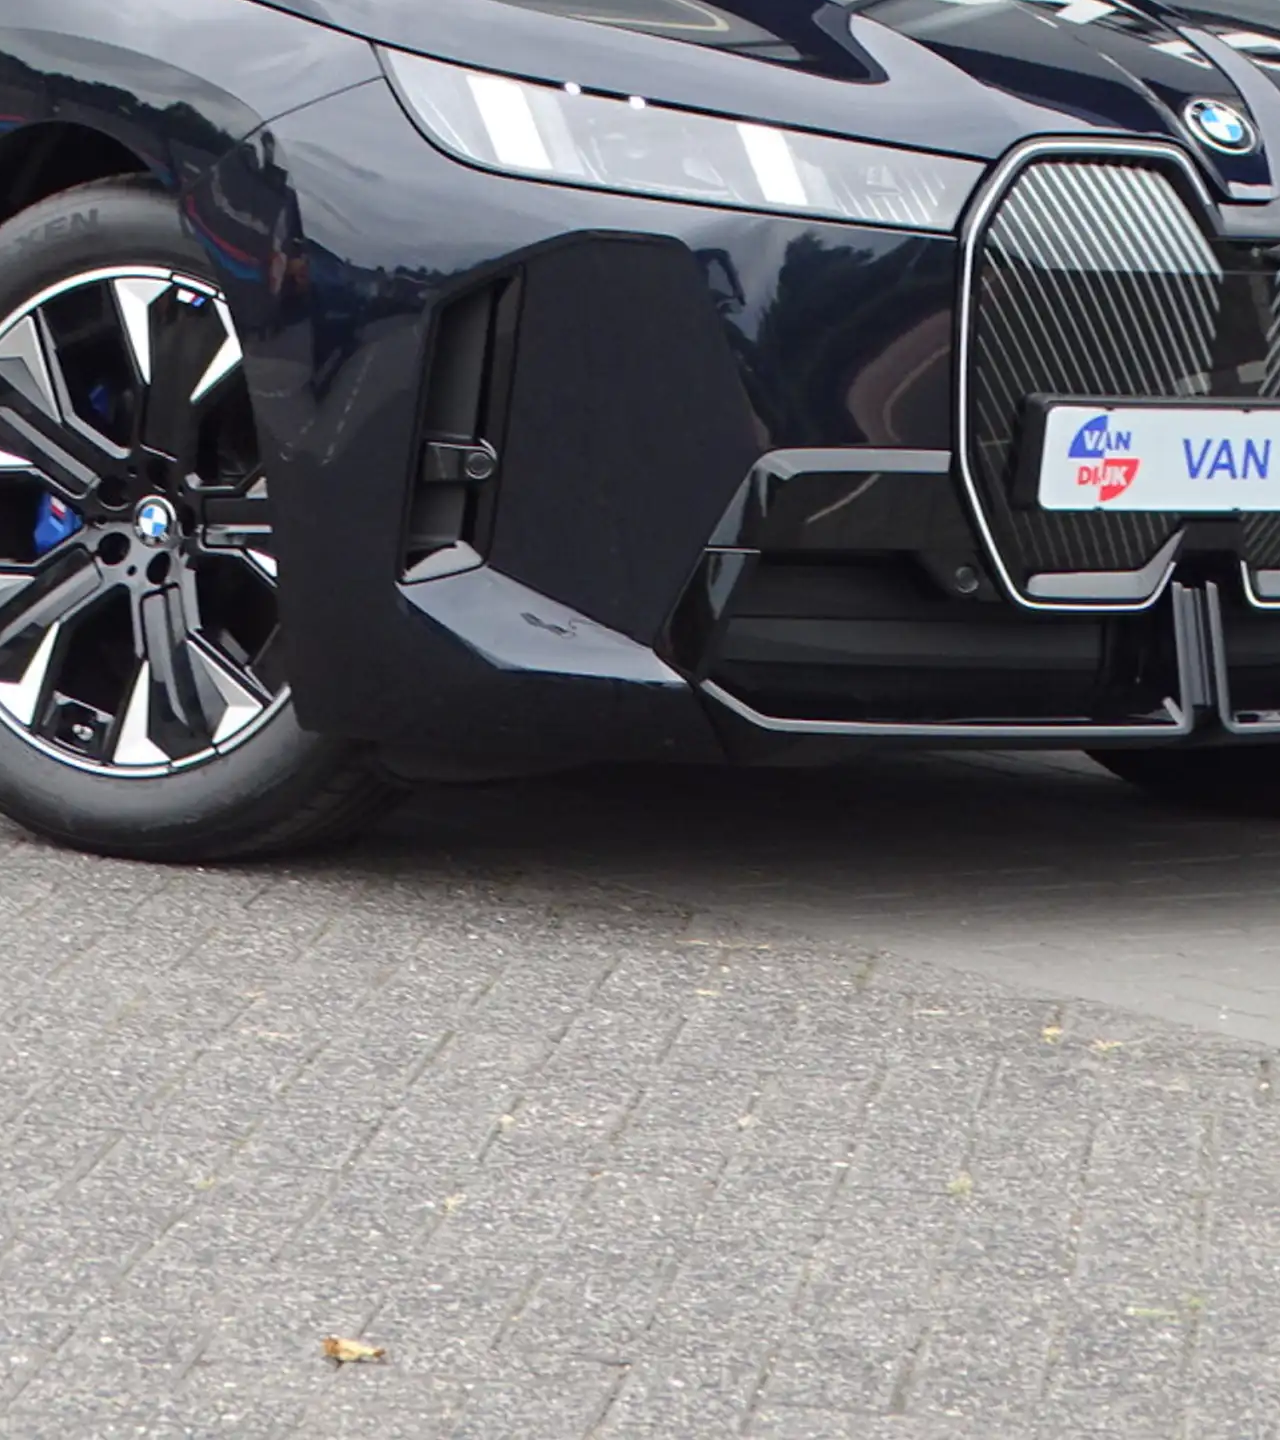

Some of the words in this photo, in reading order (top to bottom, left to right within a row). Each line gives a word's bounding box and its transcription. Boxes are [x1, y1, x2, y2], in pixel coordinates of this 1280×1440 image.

[1083, 430, 1131, 451] VAN
[1183, 438, 1271, 480] VAN
[1077, 465, 1129, 486] DIJK
